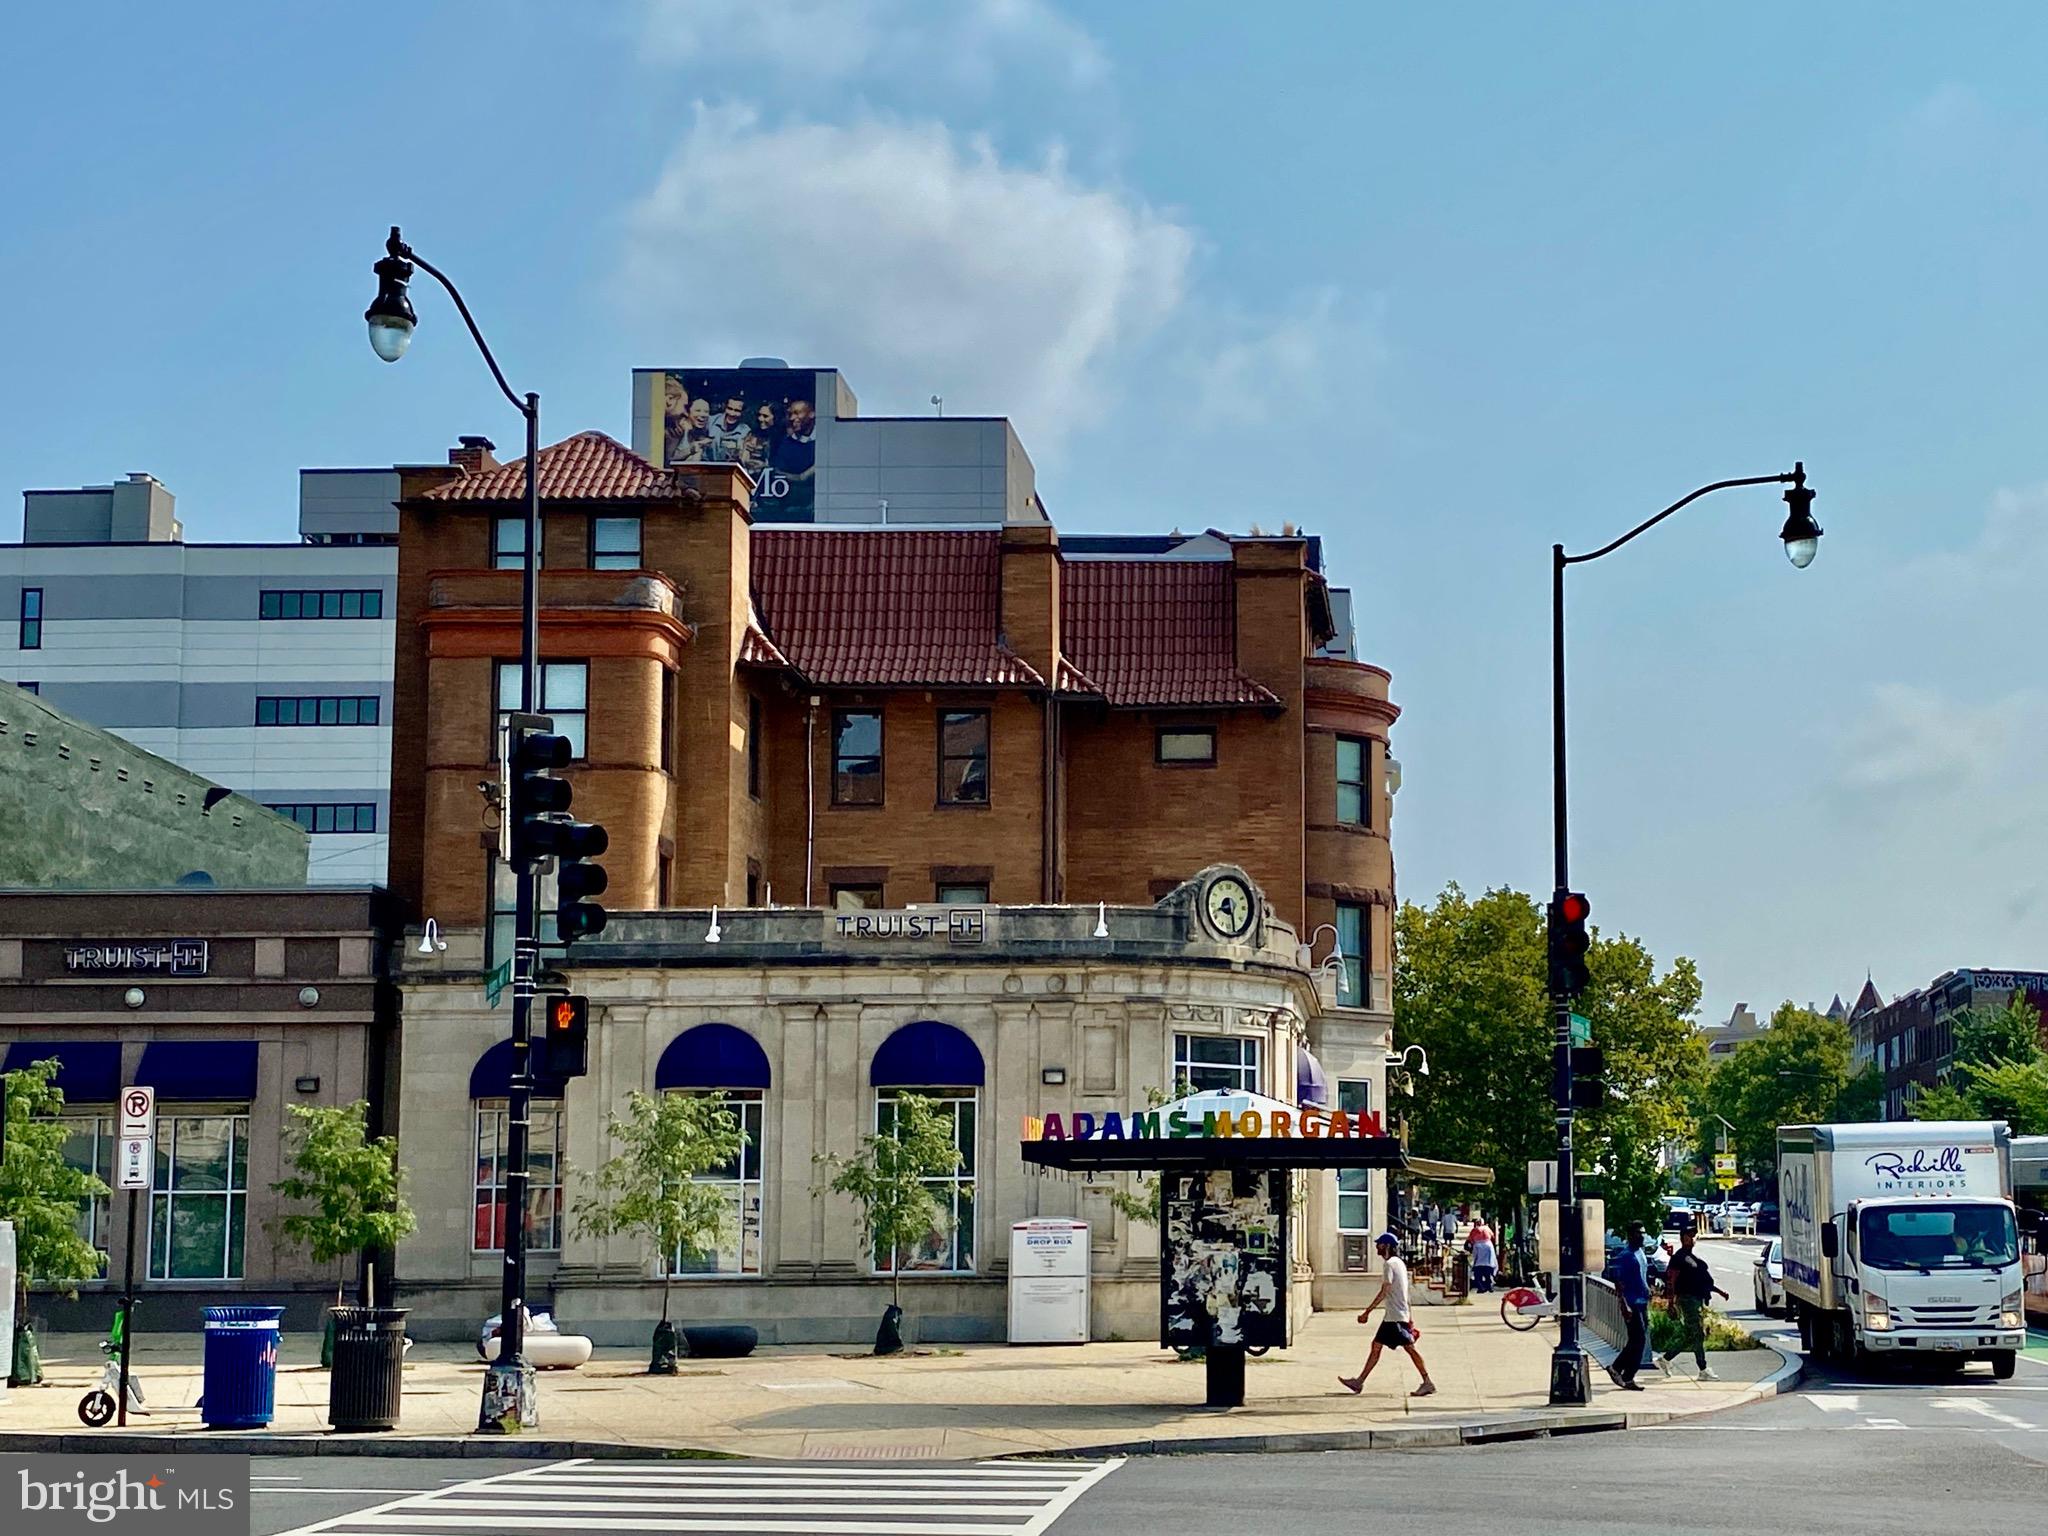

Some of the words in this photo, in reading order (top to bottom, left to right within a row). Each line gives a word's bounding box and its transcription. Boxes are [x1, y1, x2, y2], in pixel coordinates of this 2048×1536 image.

[836, 915, 941, 937] TRUIST
[65, 947, 167, 969] TRUIST
[1042, 1112, 1190, 1142] ADAMS
[1202, 1110, 1382, 1140] MORGAN
[1864, 1147, 1966, 1180] Rockville
[1877, 1179, 1966, 1189] INTERIORS
